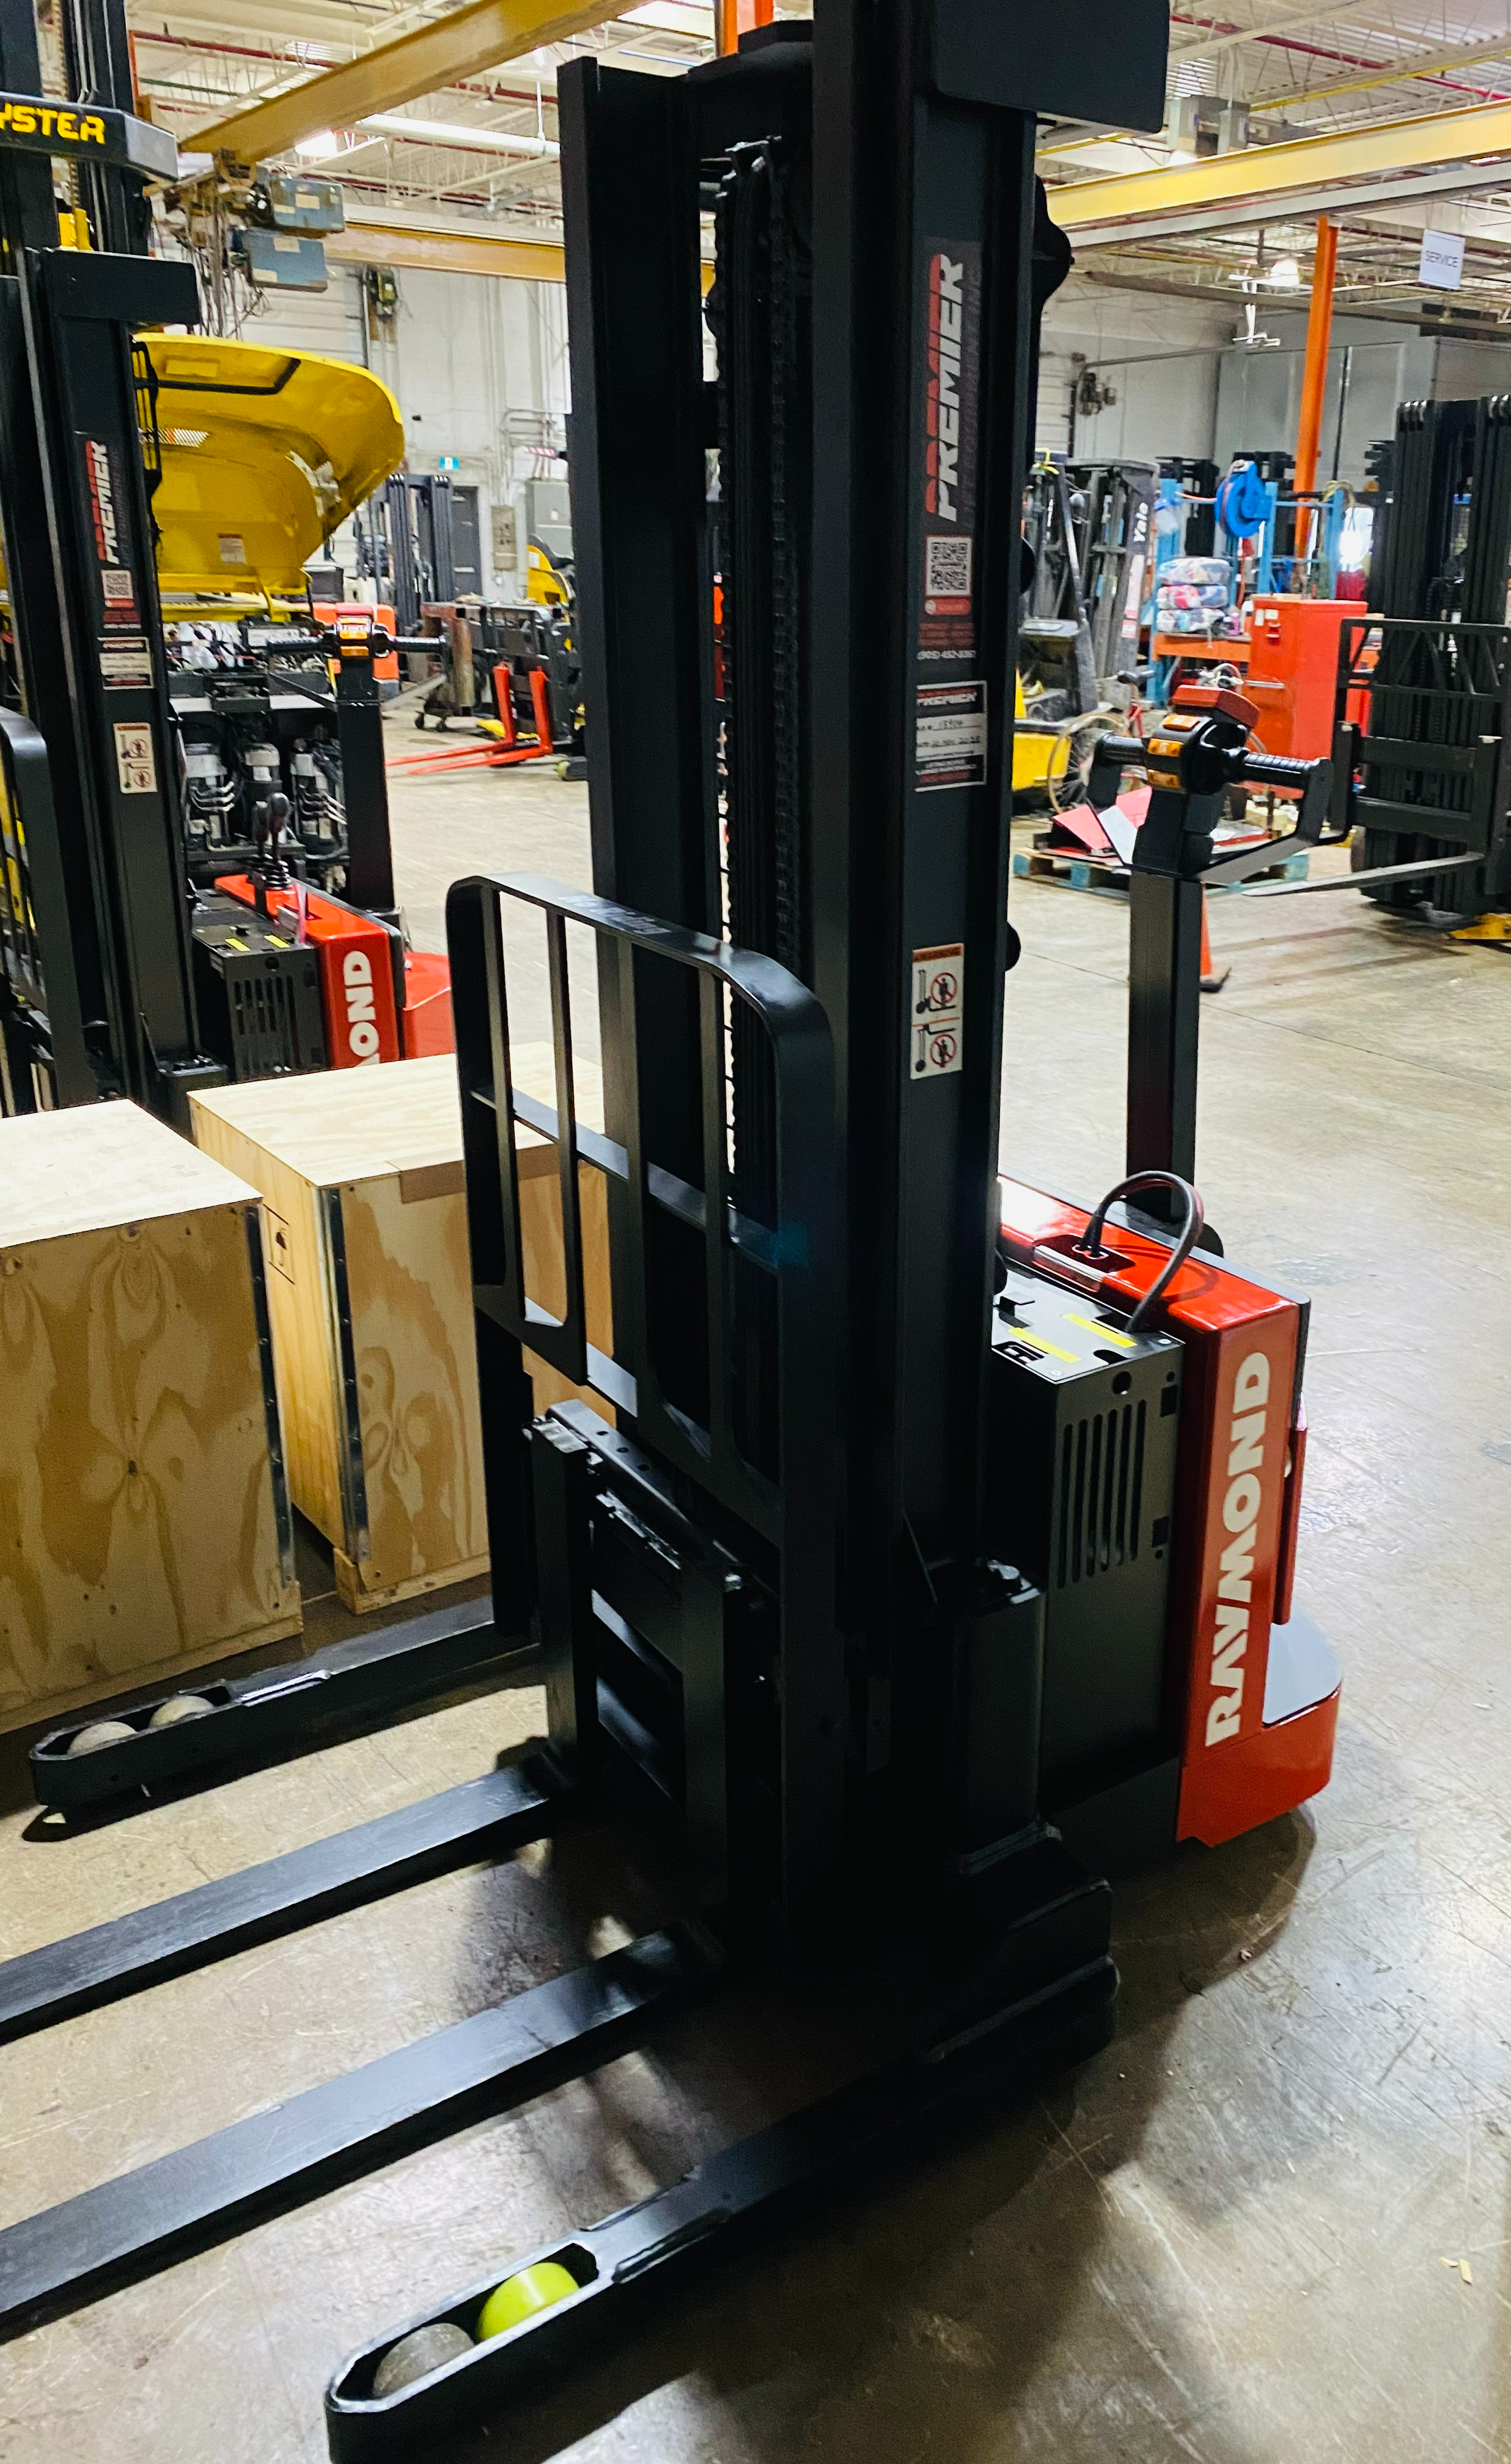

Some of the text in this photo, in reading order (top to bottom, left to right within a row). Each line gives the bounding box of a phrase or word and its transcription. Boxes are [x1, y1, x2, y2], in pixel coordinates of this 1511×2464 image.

[1425, 251, 1458, 267] SERVICE
[925, 254, 963, 522] PREMIER
[86, 440, 120, 564] PREMIER
[1133, 502, 1149, 541] Yale
[1205, 1352, 1270, 1746] RAYMOND
